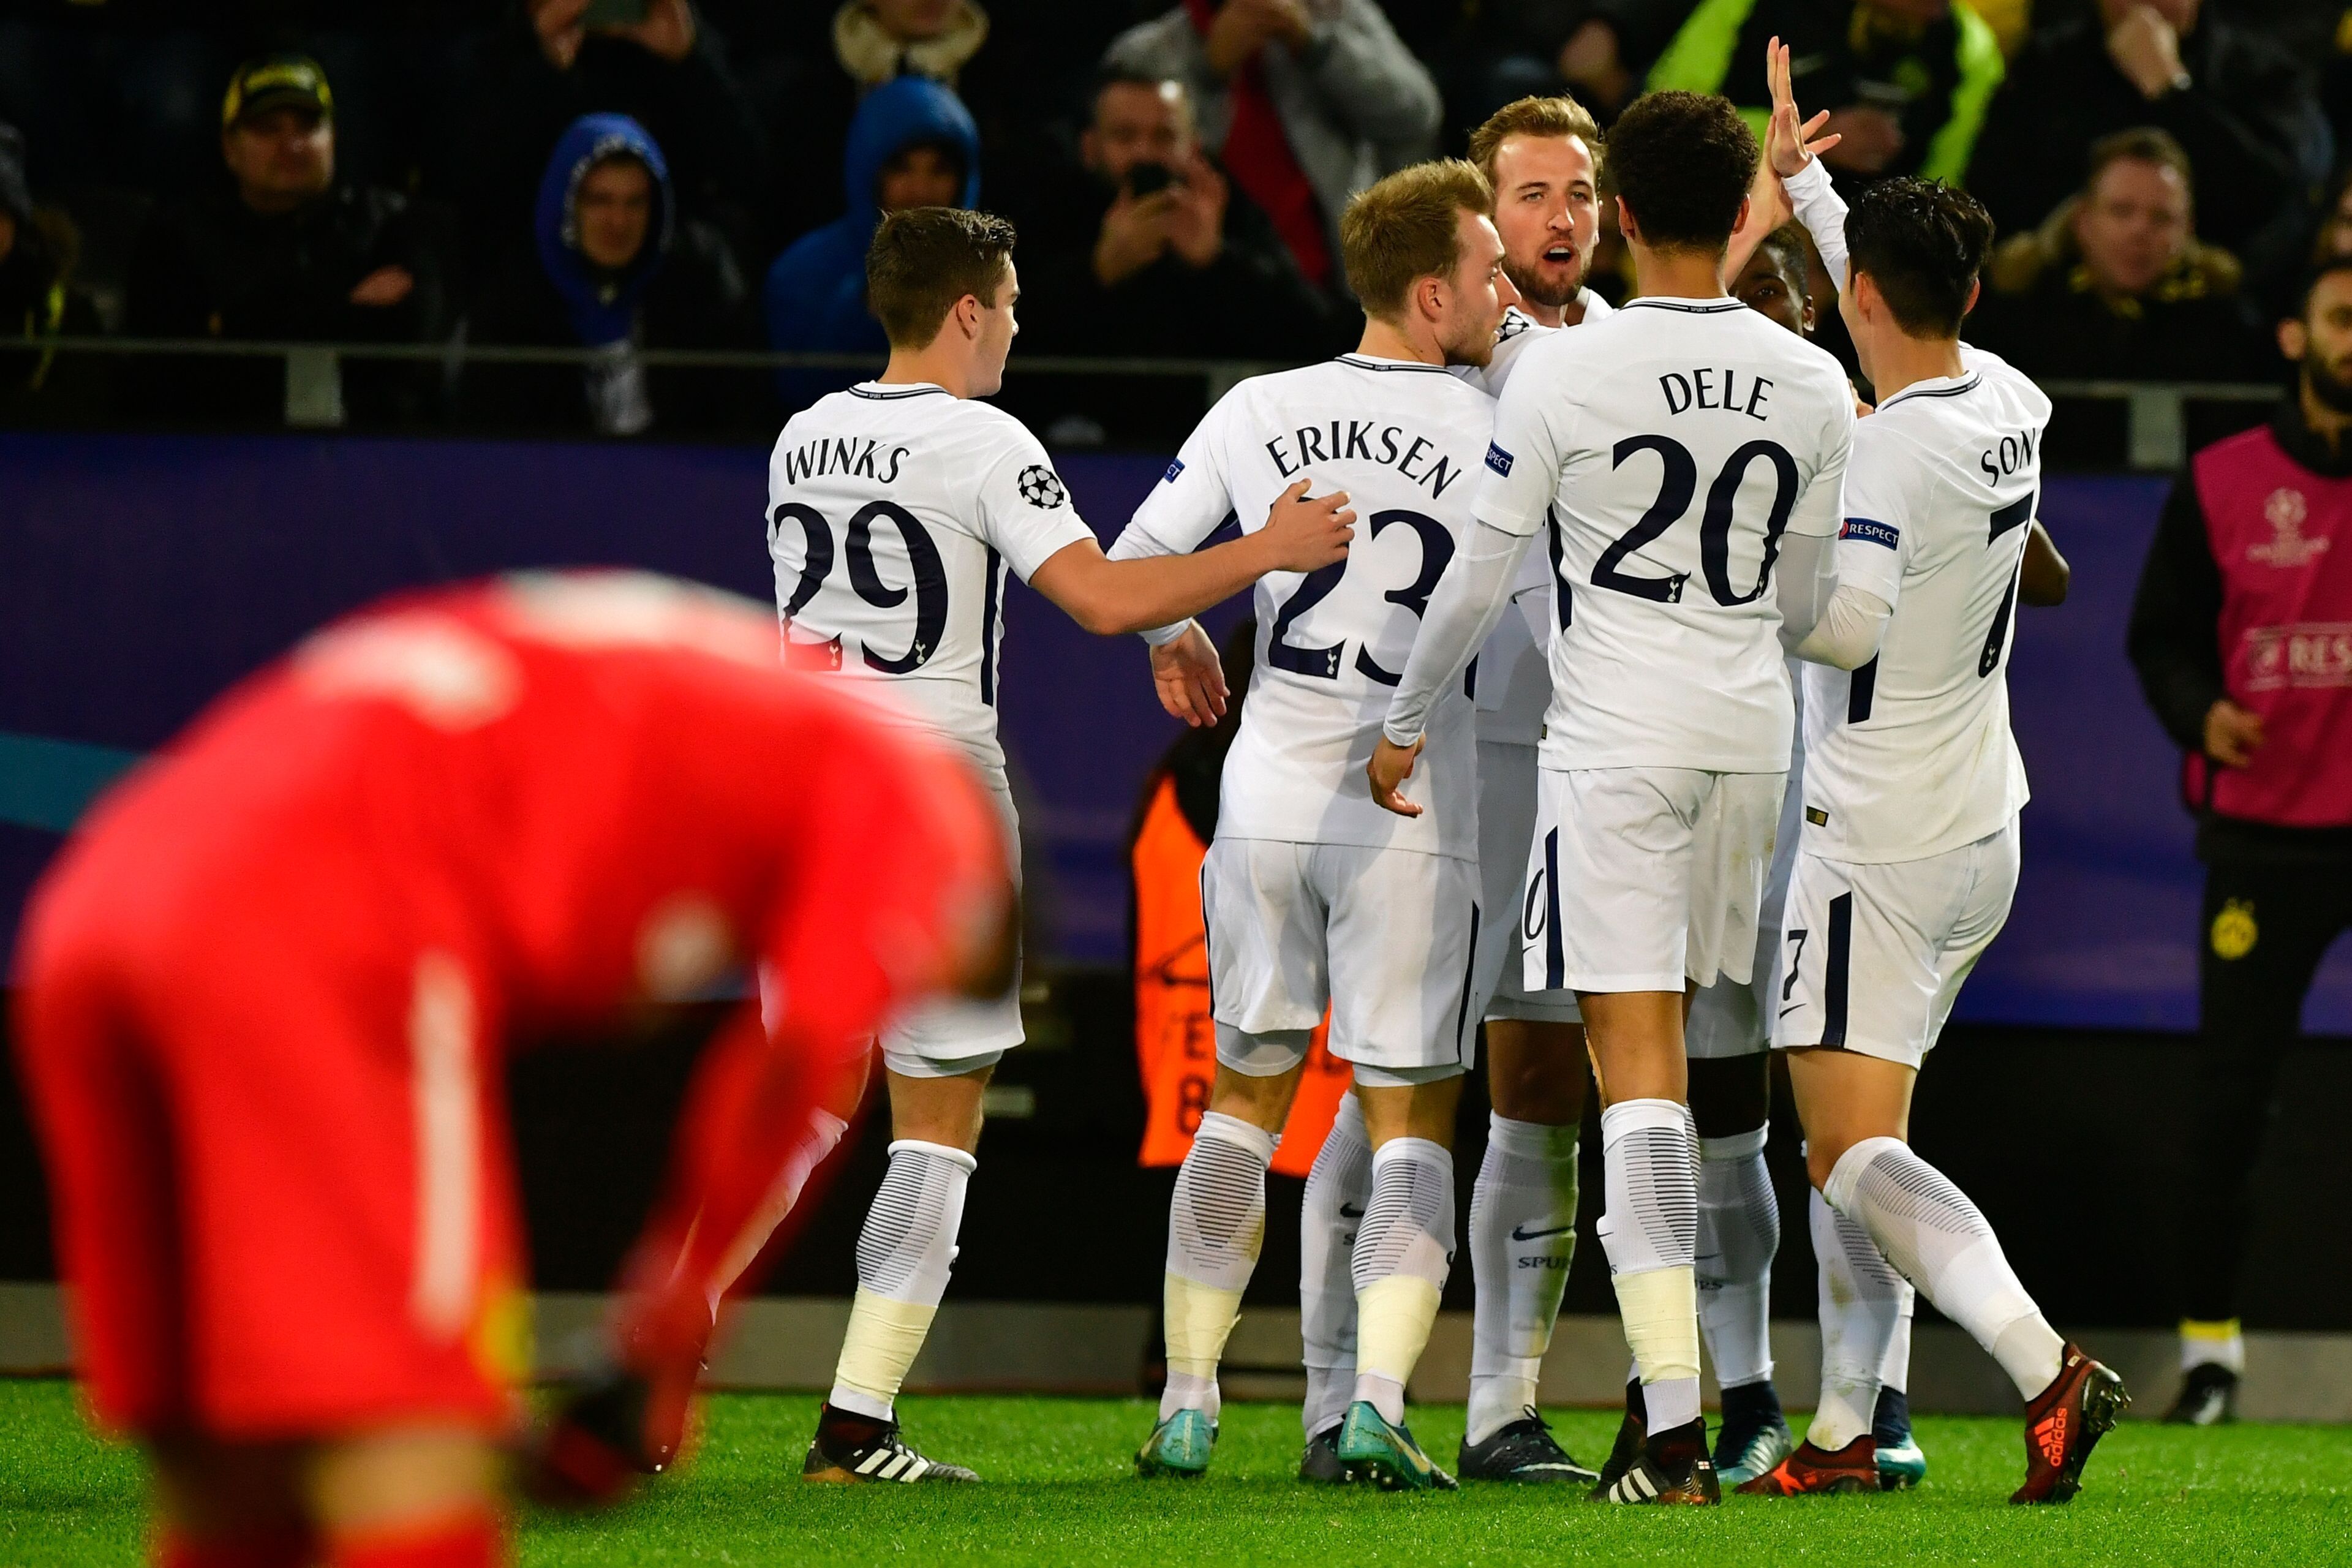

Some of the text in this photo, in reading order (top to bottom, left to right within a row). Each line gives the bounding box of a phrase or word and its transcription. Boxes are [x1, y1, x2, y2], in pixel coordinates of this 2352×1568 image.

[1659, 368, 1774, 421] DELE
[785, 437, 910, 484] WINKS
[1265, 420, 1463, 500] ERIKSEN
[1487, 447, 1512, 471] SPECT
[1981, 428, 2035, 488] SON
[1590, 434, 1799, 606] 20
[1849, 523, 1898, 545] RESPECT
[774, 500, 948, 674] 29
[1268, 497, 1456, 687] 23
[1978, 489, 2035, 678] 7
[1526, 869, 1546, 940] 0
[1783, 930, 1807, 1001] 7
[2050, 1408, 2068, 1467] adidas
